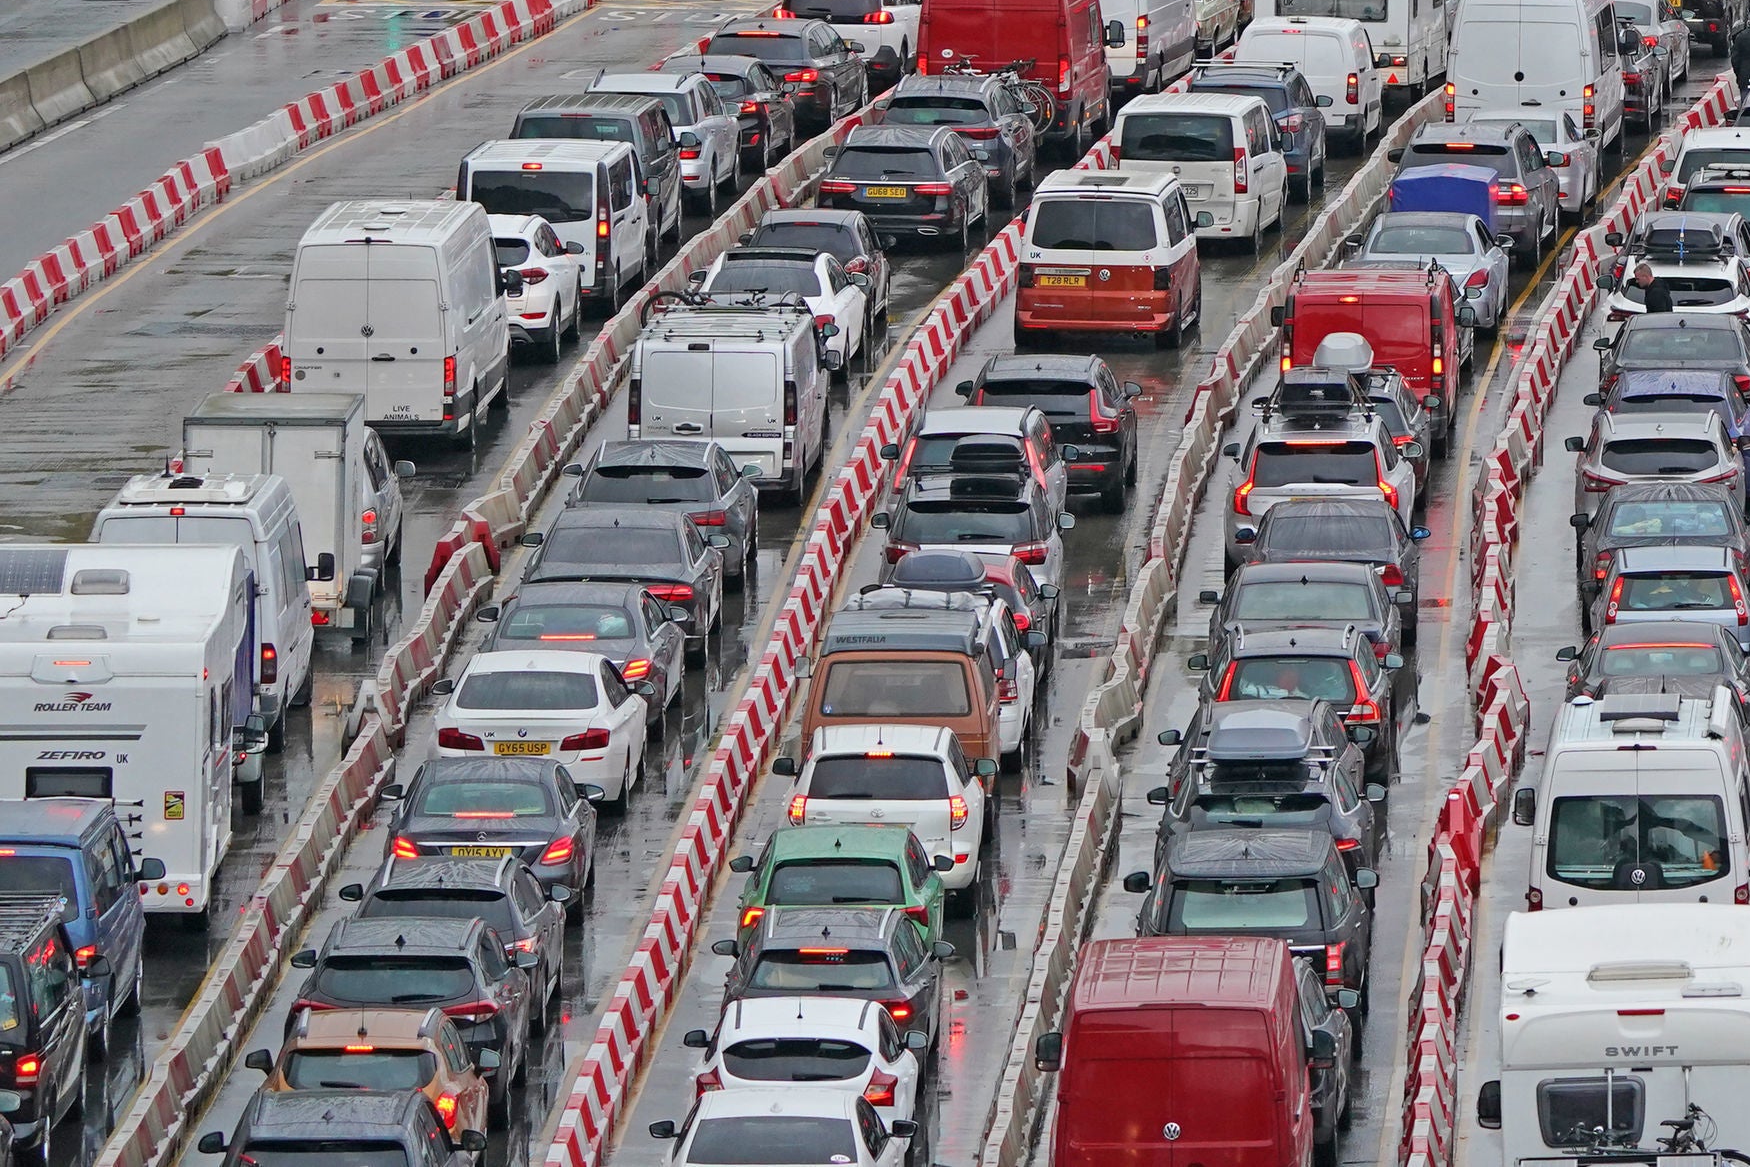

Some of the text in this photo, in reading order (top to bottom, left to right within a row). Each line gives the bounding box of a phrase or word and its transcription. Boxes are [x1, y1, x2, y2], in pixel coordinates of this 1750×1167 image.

[867, 188, 887, 197] GU68
[34, 702, 111, 712] ROLLER TEAM
[497, 744, 547, 754] GY65 USP
[37, 751, 106, 760] ZEFIRO
[117, 754, 128, 764] UK
[1606, 1046, 1679, 1056] SWIFT
